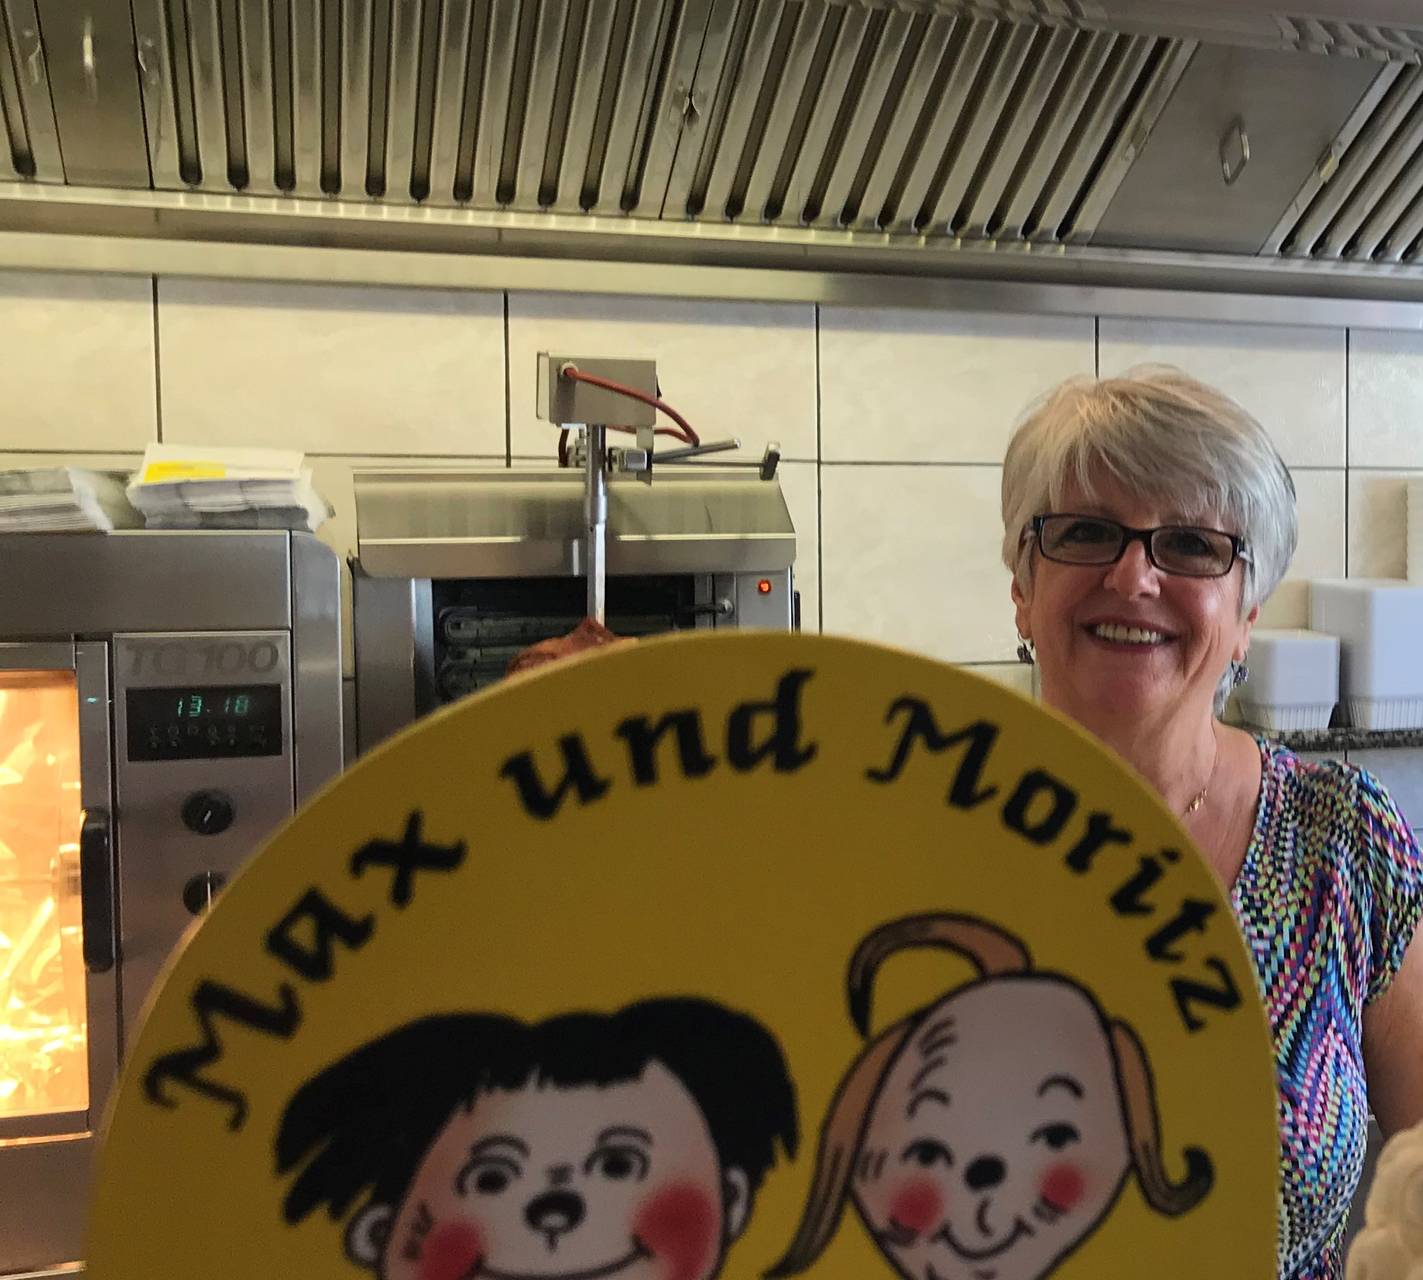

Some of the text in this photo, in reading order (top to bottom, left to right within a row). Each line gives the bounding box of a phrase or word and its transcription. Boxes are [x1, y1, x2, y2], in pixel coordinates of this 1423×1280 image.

[143, 668, 1243, 1132] Max und Moritz
